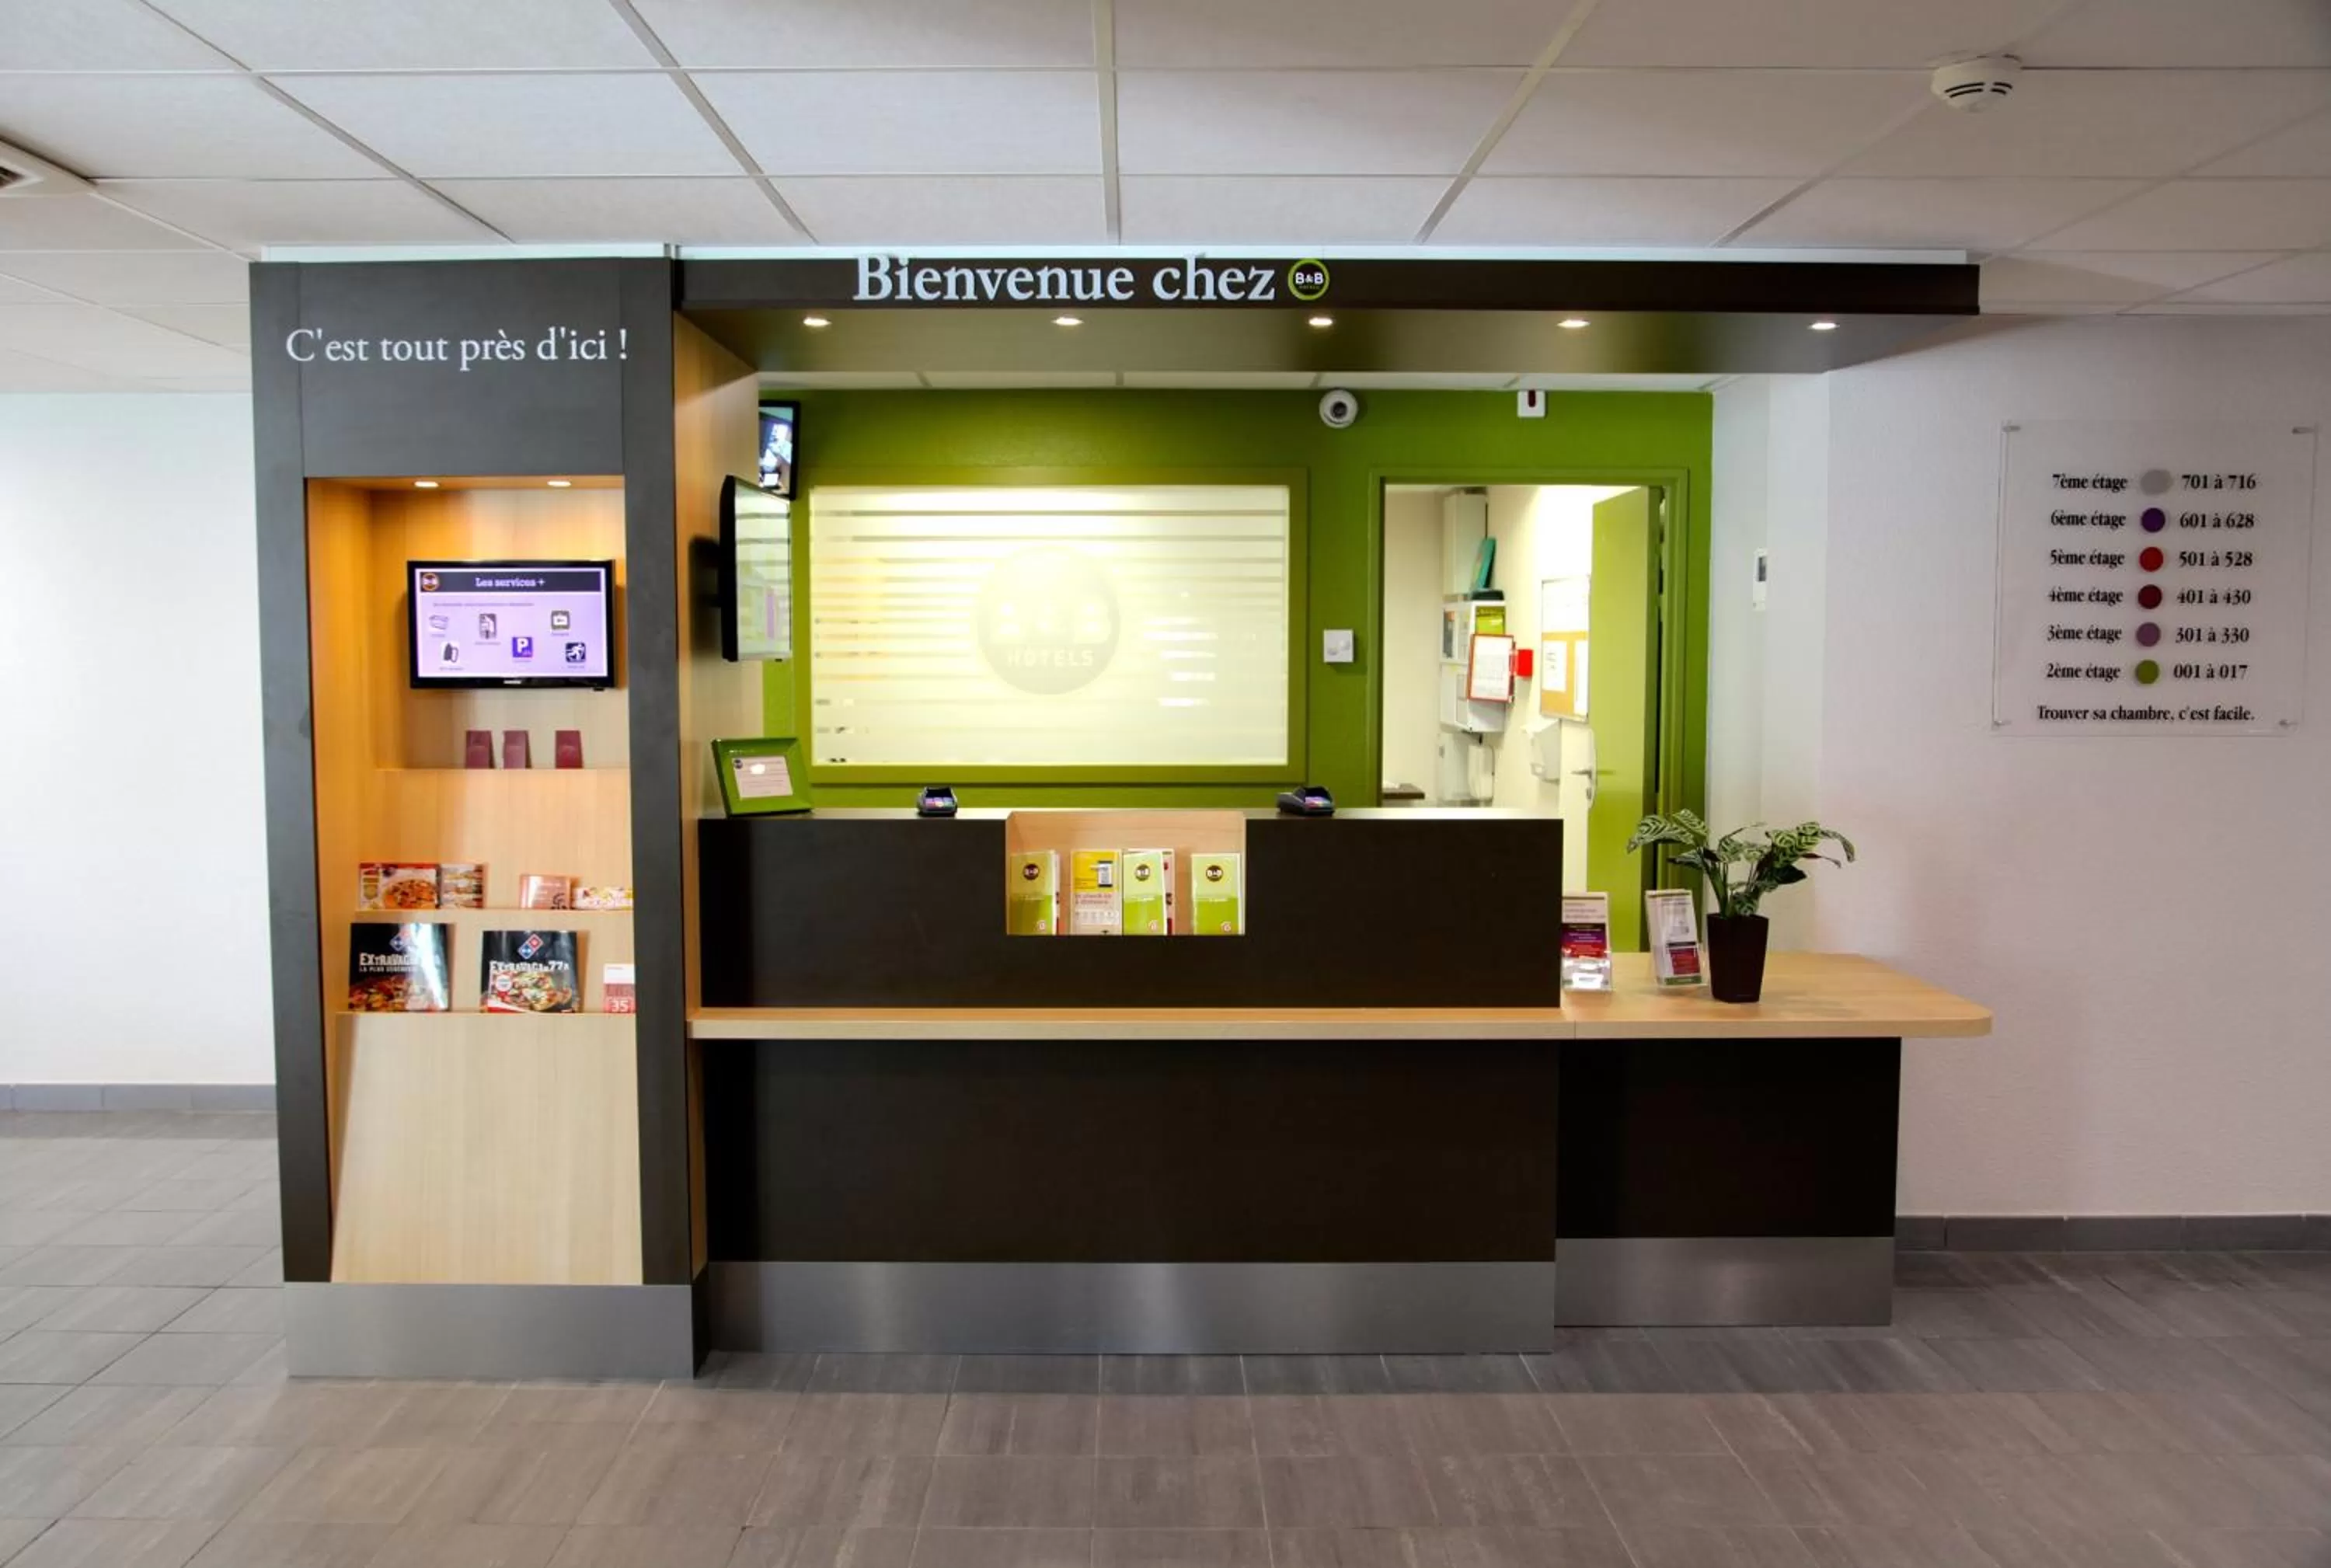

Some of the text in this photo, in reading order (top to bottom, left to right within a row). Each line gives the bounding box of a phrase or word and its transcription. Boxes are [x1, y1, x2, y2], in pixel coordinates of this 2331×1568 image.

[853, 253, 1324, 301] Bienvenue chez B&B
[285, 328, 369, 361] C'est
[380, 336, 449, 361] tout
[459, 329, 525, 371] près
[537, 326, 608, 361] d'ici
[2052, 473, 2256, 493] 7ème étage 701 à 716
[2051, 510, 2254, 529] 6ème étage 601 à 628
[2050, 549, 2253, 569] 5ème étage 501 à 528
[475, 577, 493, 587] Les
[2048, 587, 2251, 606] 4ème étage 401 à 430
[2047, 624, 2249, 643] 3ème étage 301 à 330
[2047, 663, 2248, 681] 2ème étage 001 à 017
[2037, 705, 2255, 722] Trouver sa chambre, c'est facile.
